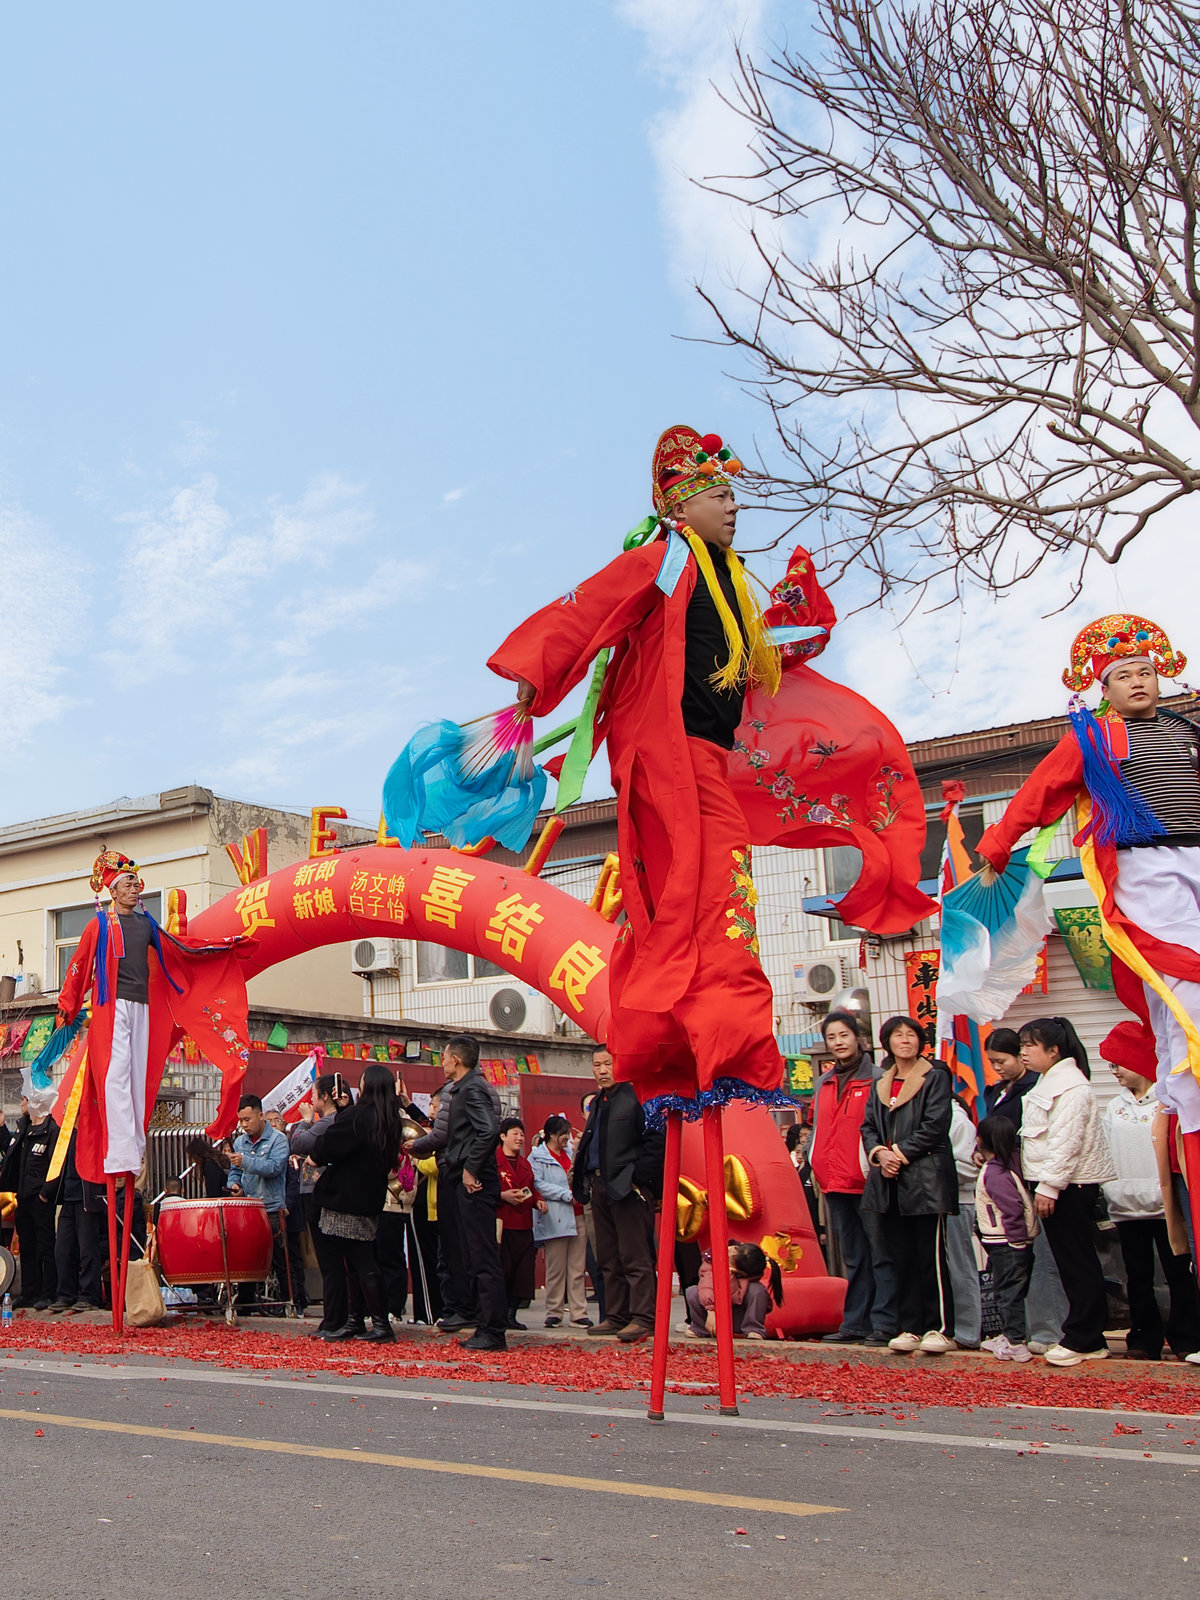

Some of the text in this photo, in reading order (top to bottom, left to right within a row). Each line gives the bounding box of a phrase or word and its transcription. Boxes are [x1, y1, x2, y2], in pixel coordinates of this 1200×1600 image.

[293, 859, 406, 897] 新郎 汤文峥
[234, 880, 276, 936] 贺
[293, 887, 404, 920] 新娘 白子怡
[273, 1076, 313, 1112] 利州街道
